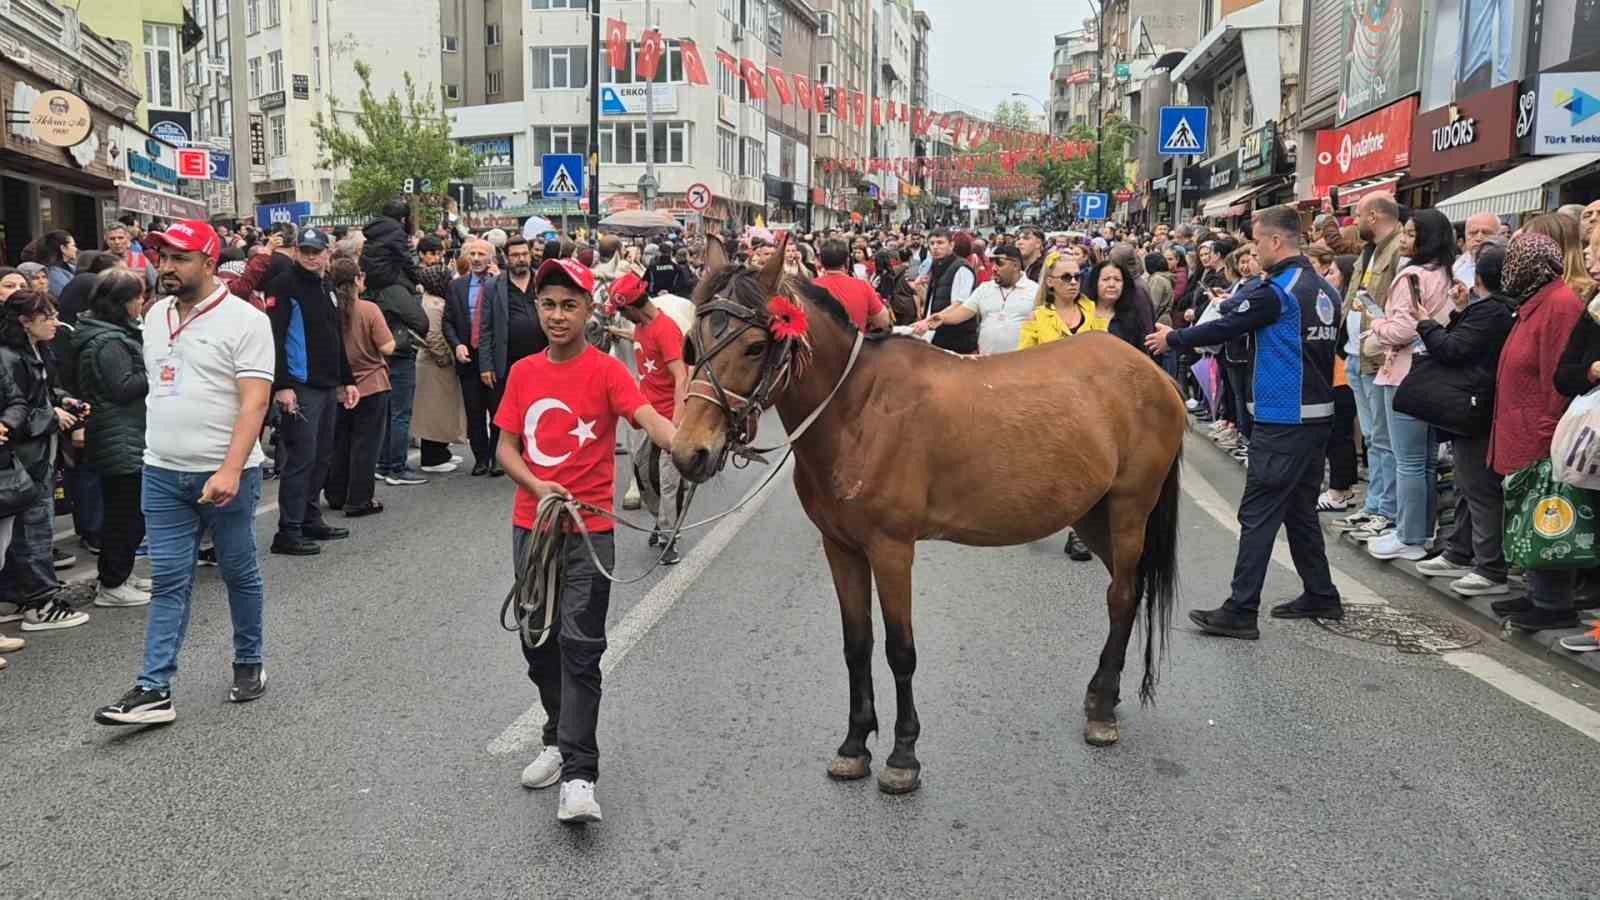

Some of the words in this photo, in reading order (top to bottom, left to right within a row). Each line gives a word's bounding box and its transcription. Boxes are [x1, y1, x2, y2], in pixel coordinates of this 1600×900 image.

[1351, 131, 1385, 159] vodafone
[1432, 118, 1474, 152] TUDORS
[1545, 135, 1567, 145] Türk
[1086, 195, 1101, 216] P
